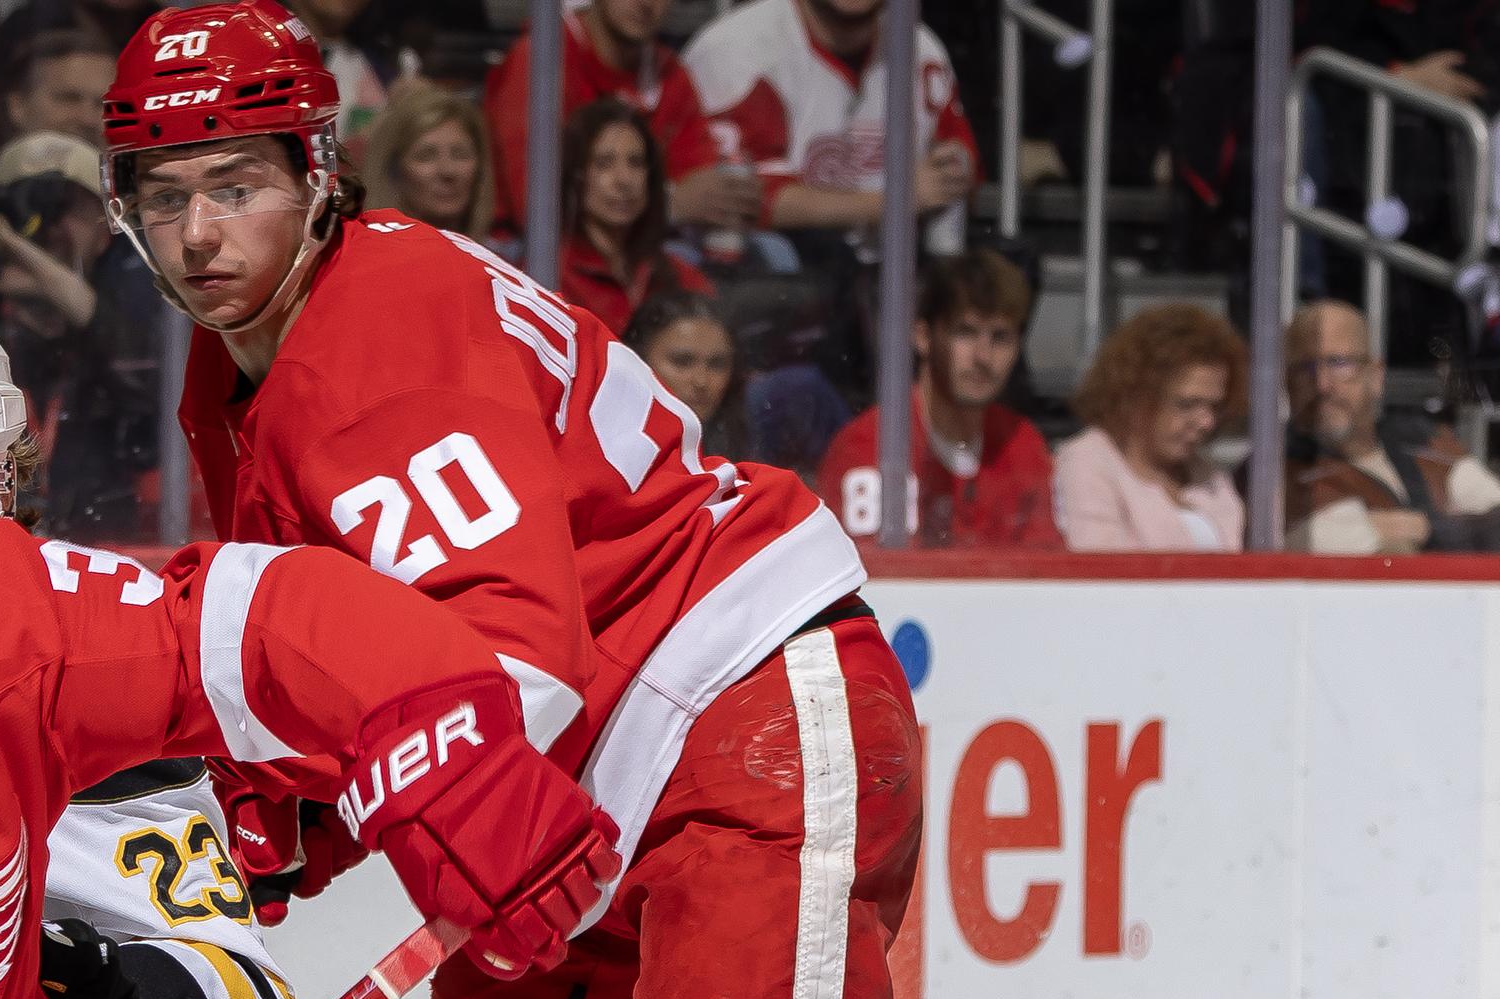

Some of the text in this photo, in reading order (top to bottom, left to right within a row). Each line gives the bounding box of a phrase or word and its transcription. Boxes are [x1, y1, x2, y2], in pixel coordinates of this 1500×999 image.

[155, 30, 211, 62] 20
[143, 87, 222, 111] CCM
[330, 432, 522, 585] 20
[39, 539, 164, 606] 3
[114, 814, 254, 928] 23
